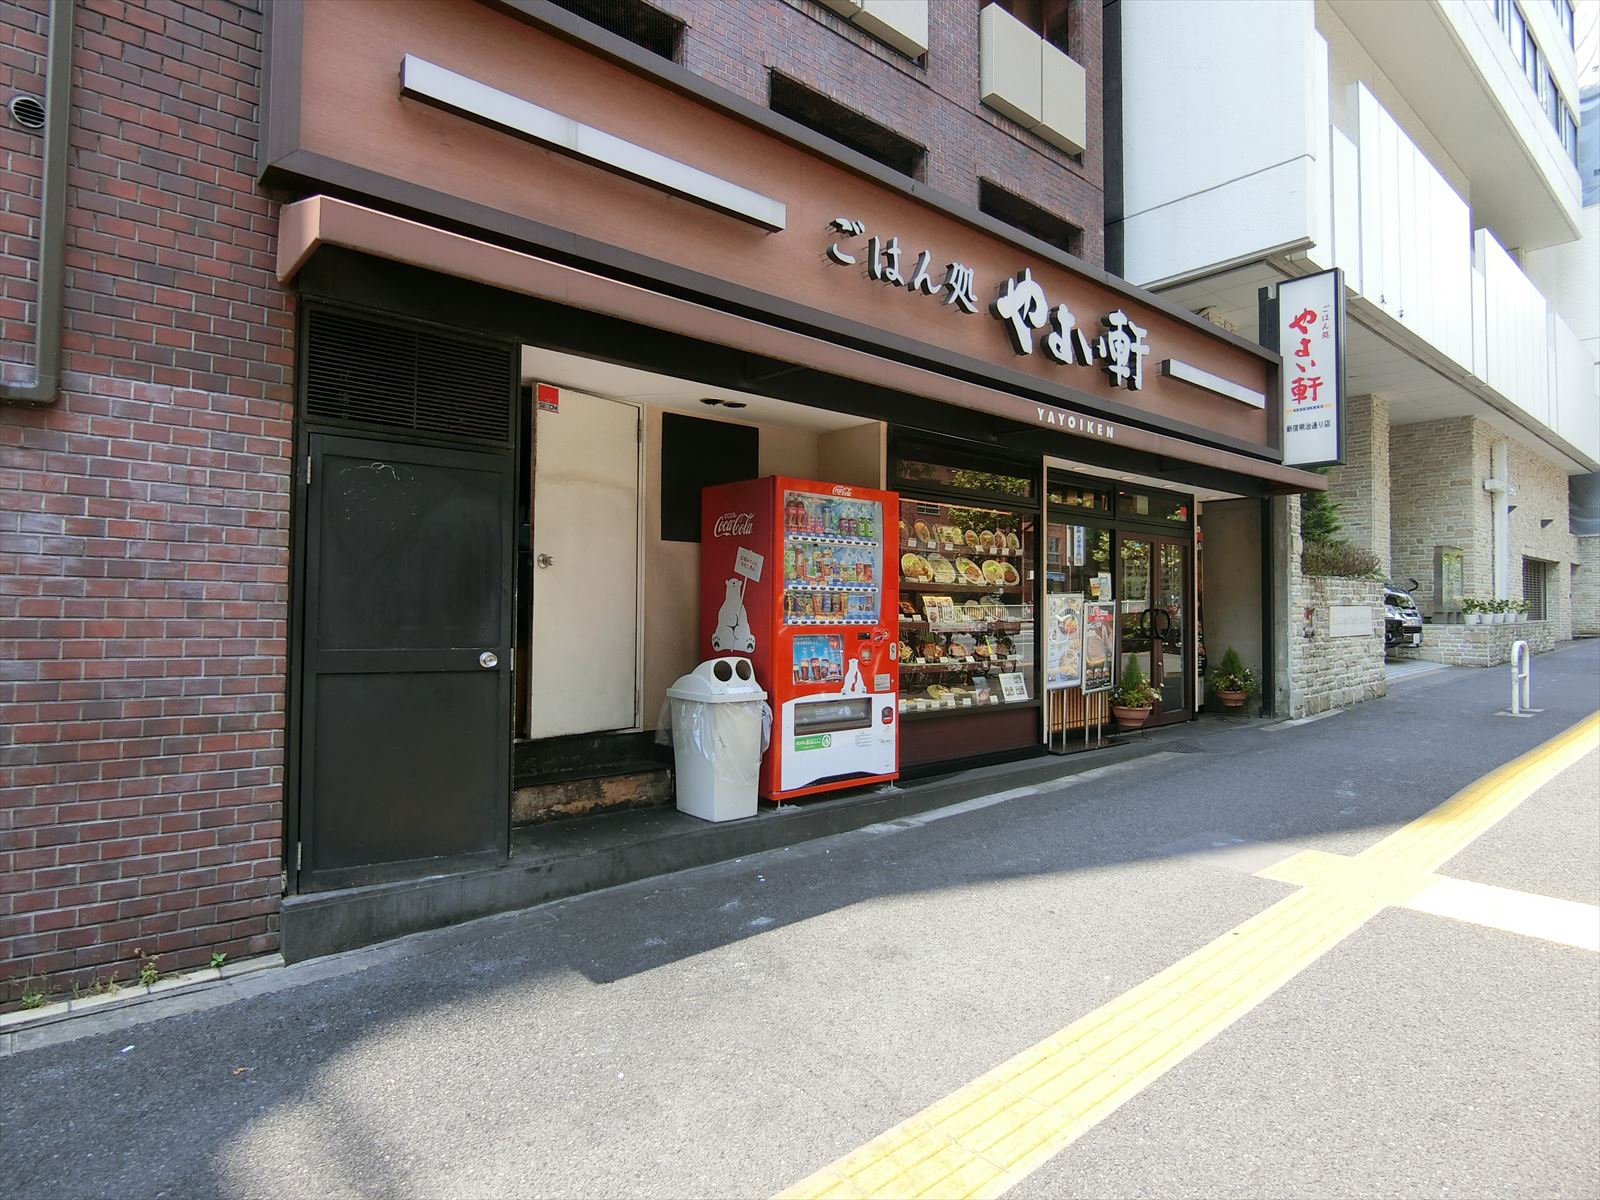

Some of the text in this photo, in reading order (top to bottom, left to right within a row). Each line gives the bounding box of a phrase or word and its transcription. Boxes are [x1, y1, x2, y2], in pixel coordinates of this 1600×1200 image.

[825, 217, 1152, 391] ごはん処 やよい軒
[1289, 307, 1324, 404] やよい軒
[1036, 407, 1115, 439] YAYOIKEN
